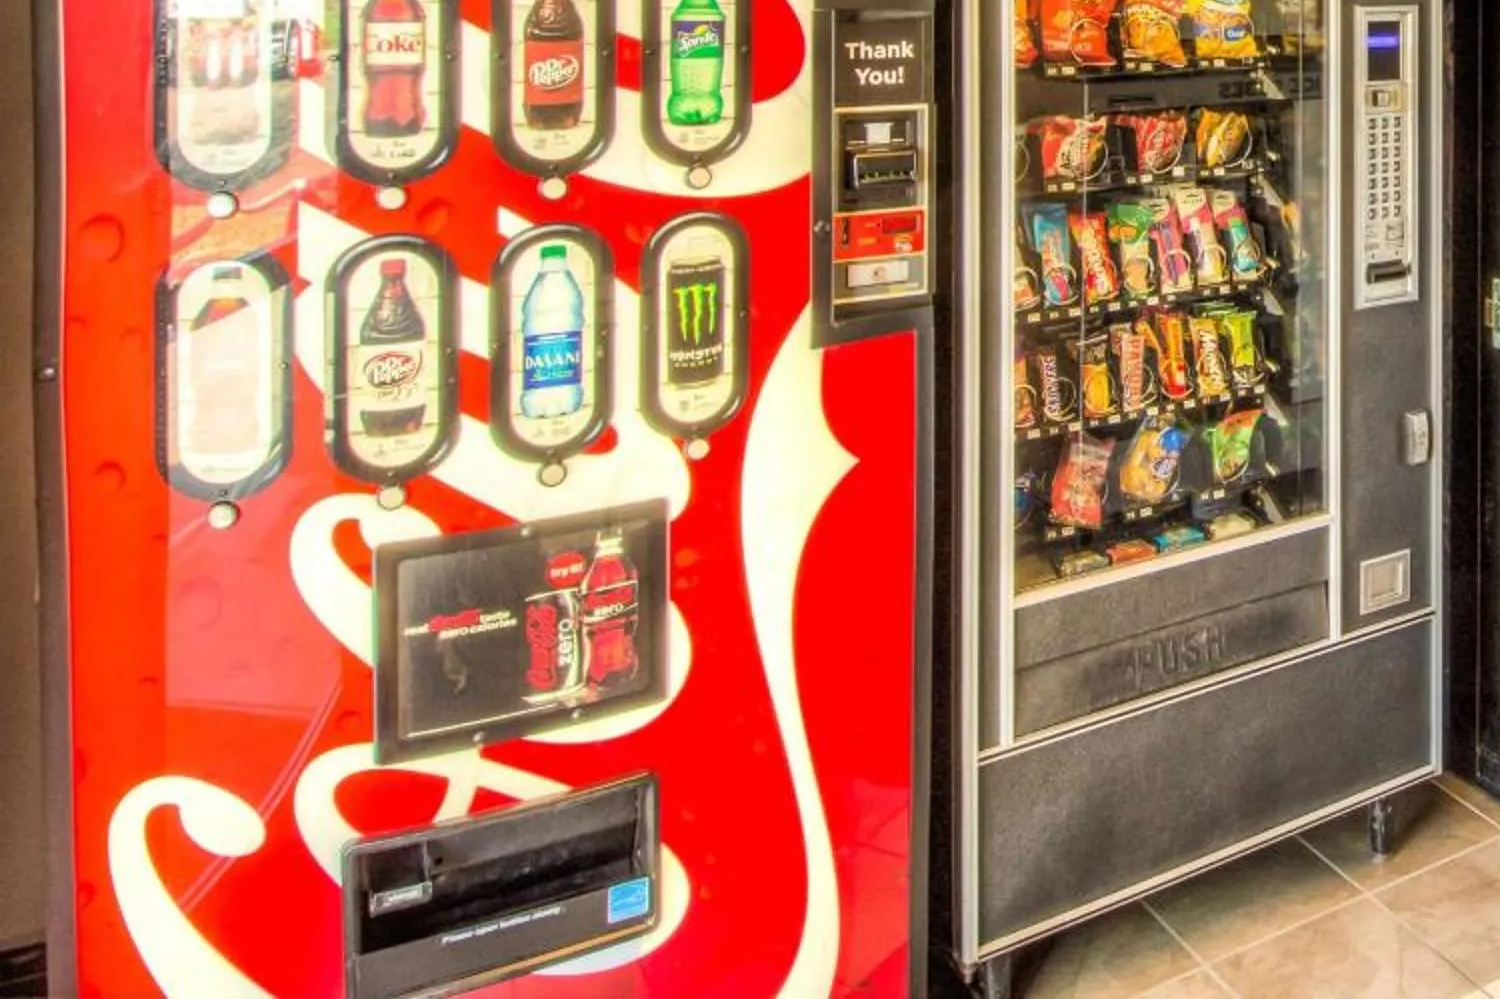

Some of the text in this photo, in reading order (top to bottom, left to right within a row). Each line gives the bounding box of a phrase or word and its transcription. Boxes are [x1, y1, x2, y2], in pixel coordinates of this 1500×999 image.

[679, 31, 719, 58] Sprite
[844, 40, 915, 61] Thank
[531, 61, 577, 87] Pepper
[854, 66, 905, 86] You!
[371, 360, 415, 384] Pepper
[525, 351, 580, 369] DASANI
[558, 618, 575, 667] zero
[1133, 626, 1225, 687] PUSH
